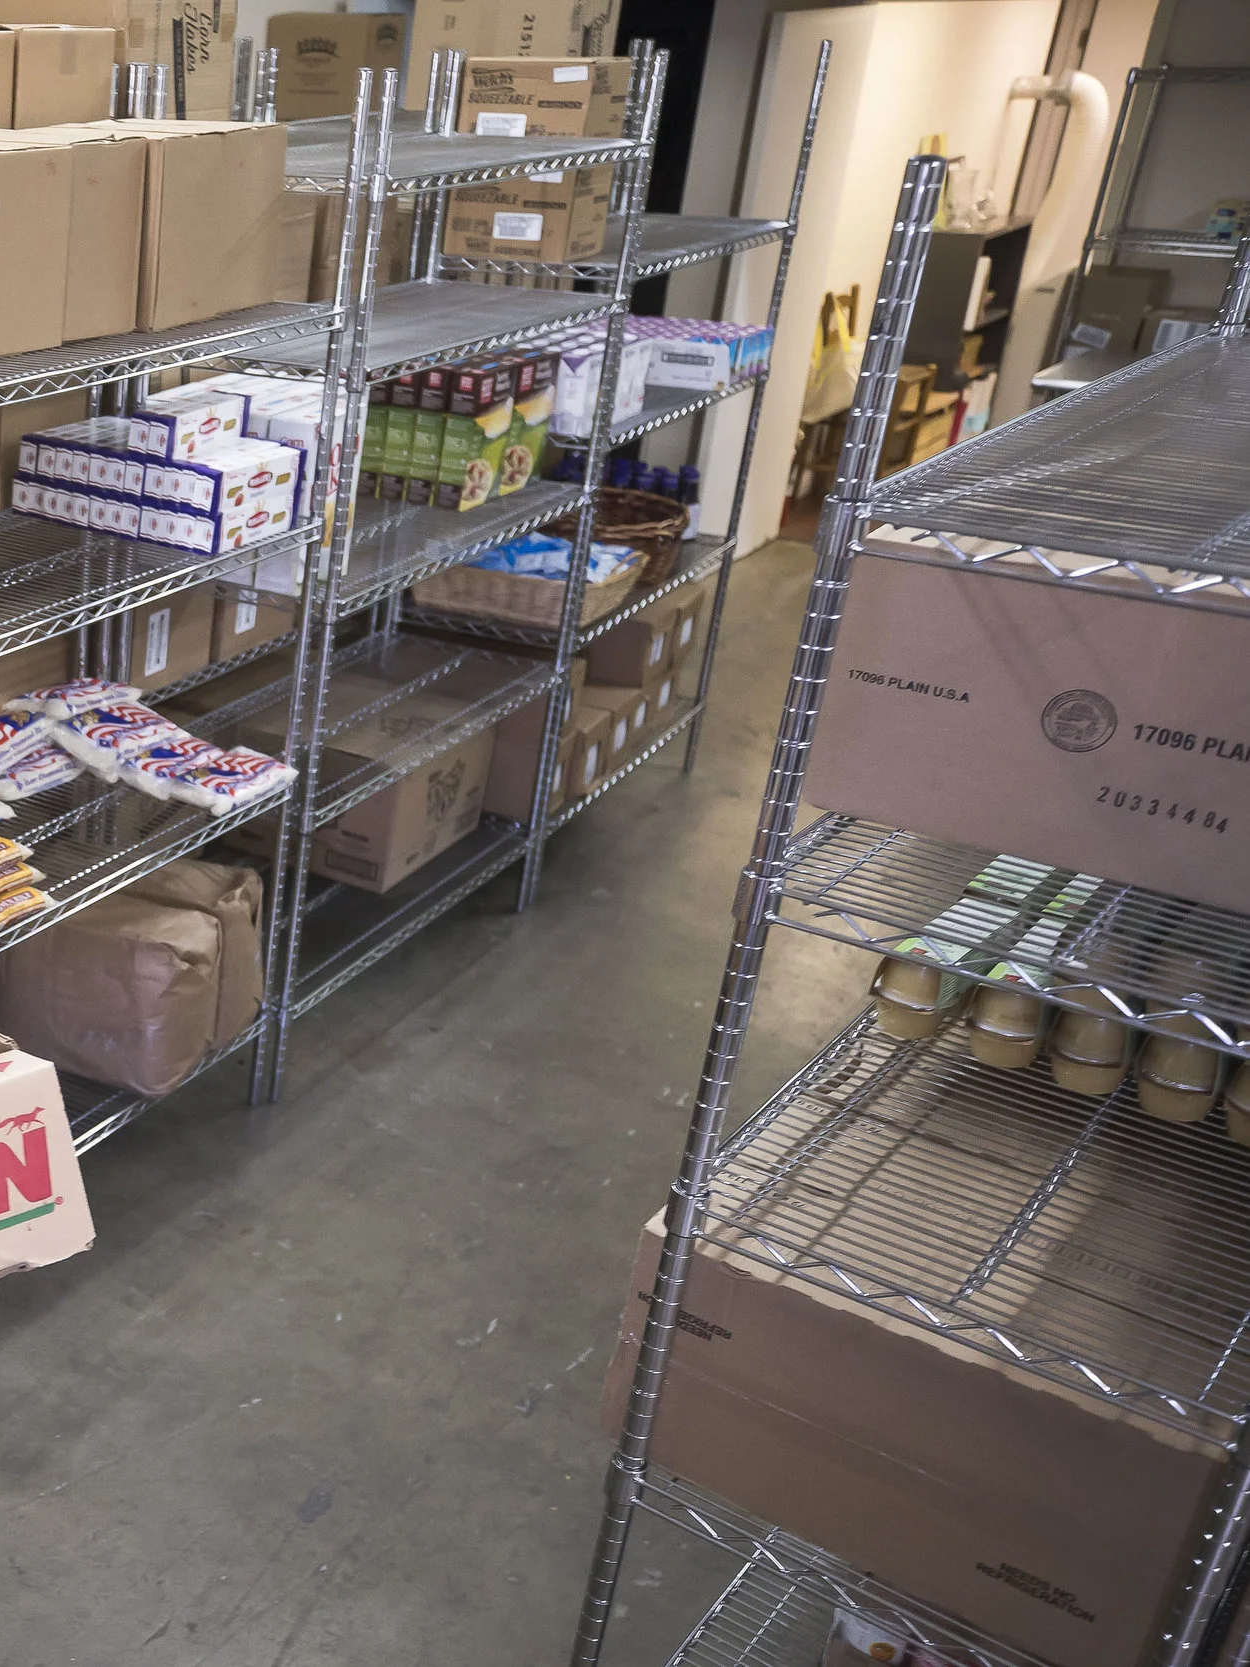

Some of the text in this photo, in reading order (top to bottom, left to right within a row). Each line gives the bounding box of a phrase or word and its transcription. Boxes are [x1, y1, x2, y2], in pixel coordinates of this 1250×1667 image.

[184, 2, 199, 75] Flakes
[199, 12, 214, 64] Corn
[518, 14, 535, 56] 2151
[848, 669, 970, 703] 17096 PLAIN U.S.A
[1134, 723, 1197, 751] 17096
[678, 1321, 712, 1341] NEED
